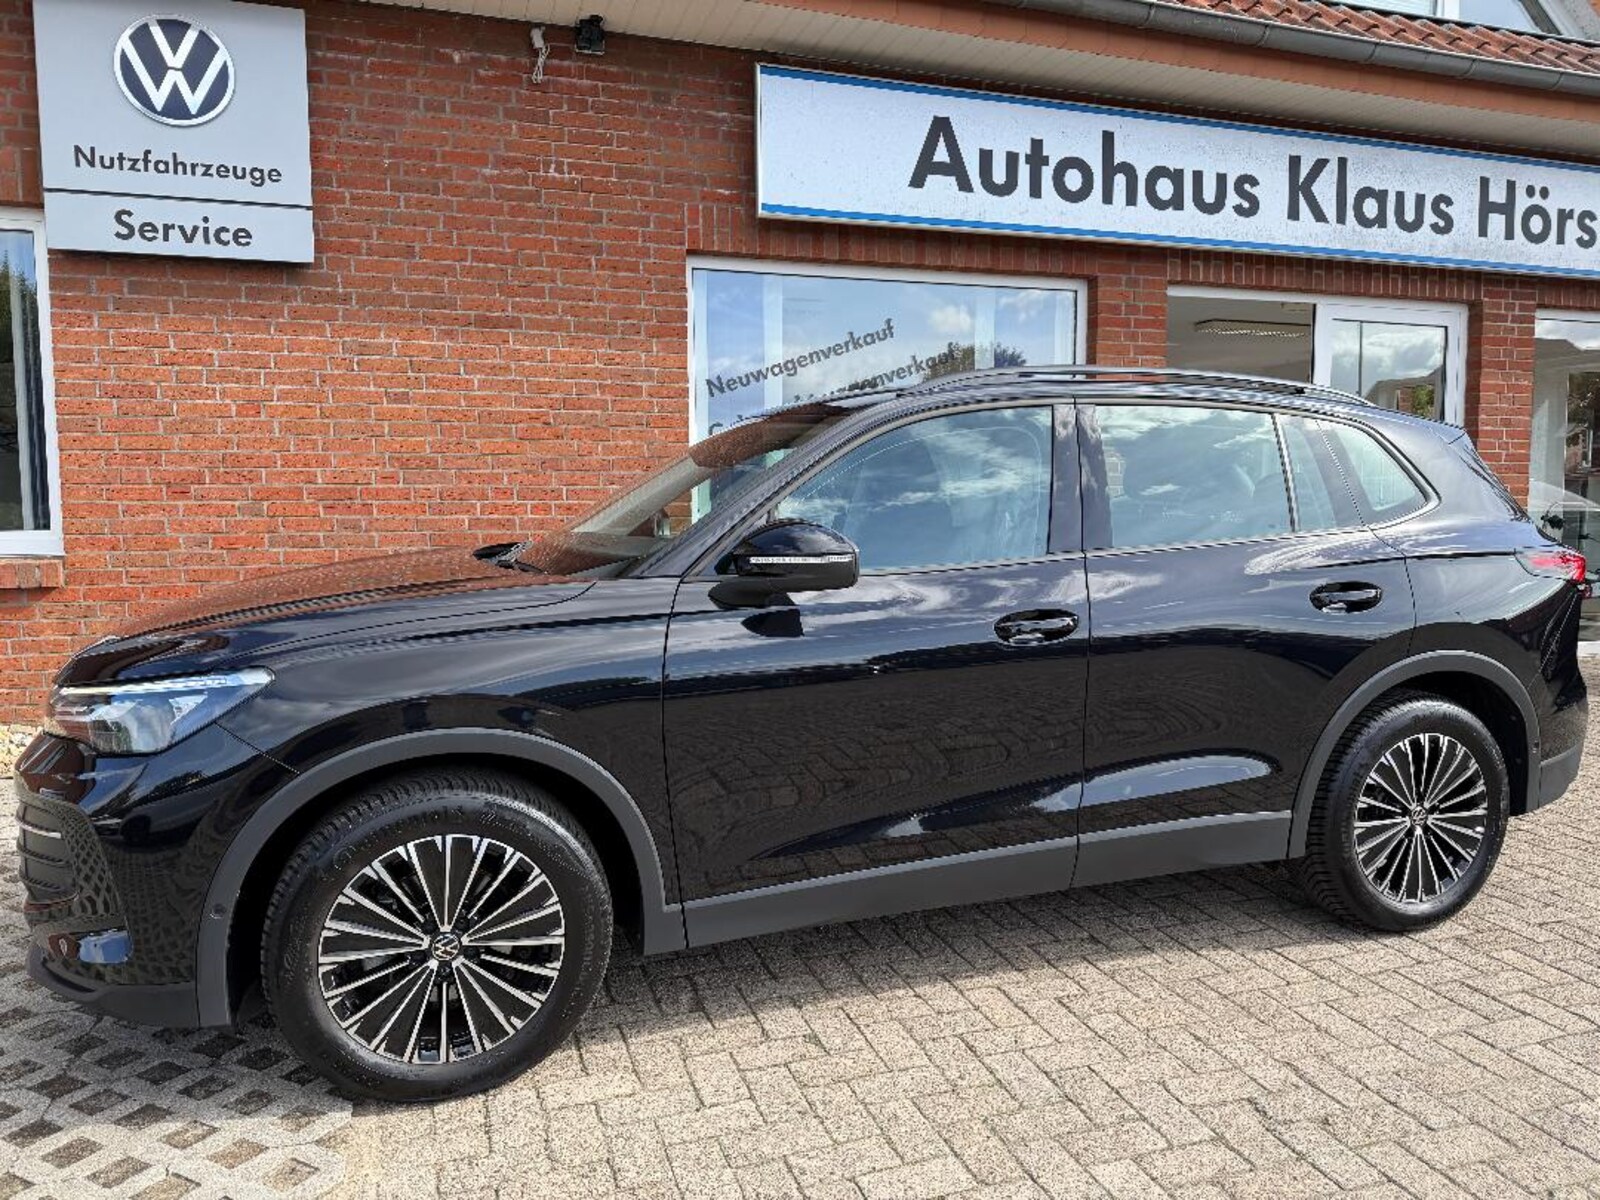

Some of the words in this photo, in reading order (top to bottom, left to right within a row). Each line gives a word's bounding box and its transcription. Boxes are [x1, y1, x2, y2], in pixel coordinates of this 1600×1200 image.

[115, 15, 234, 126] VW
[73, 144, 282, 187] Nutzfahrzeuge
[908, 115, 1260, 218] Autohaus
[1286, 153, 1454, 236] Klaus
[1478, 175, 1598, 249] Hörs
[113, 208, 252, 247] Service
[705, 317, 894, 397] Neuwagenverkauf
